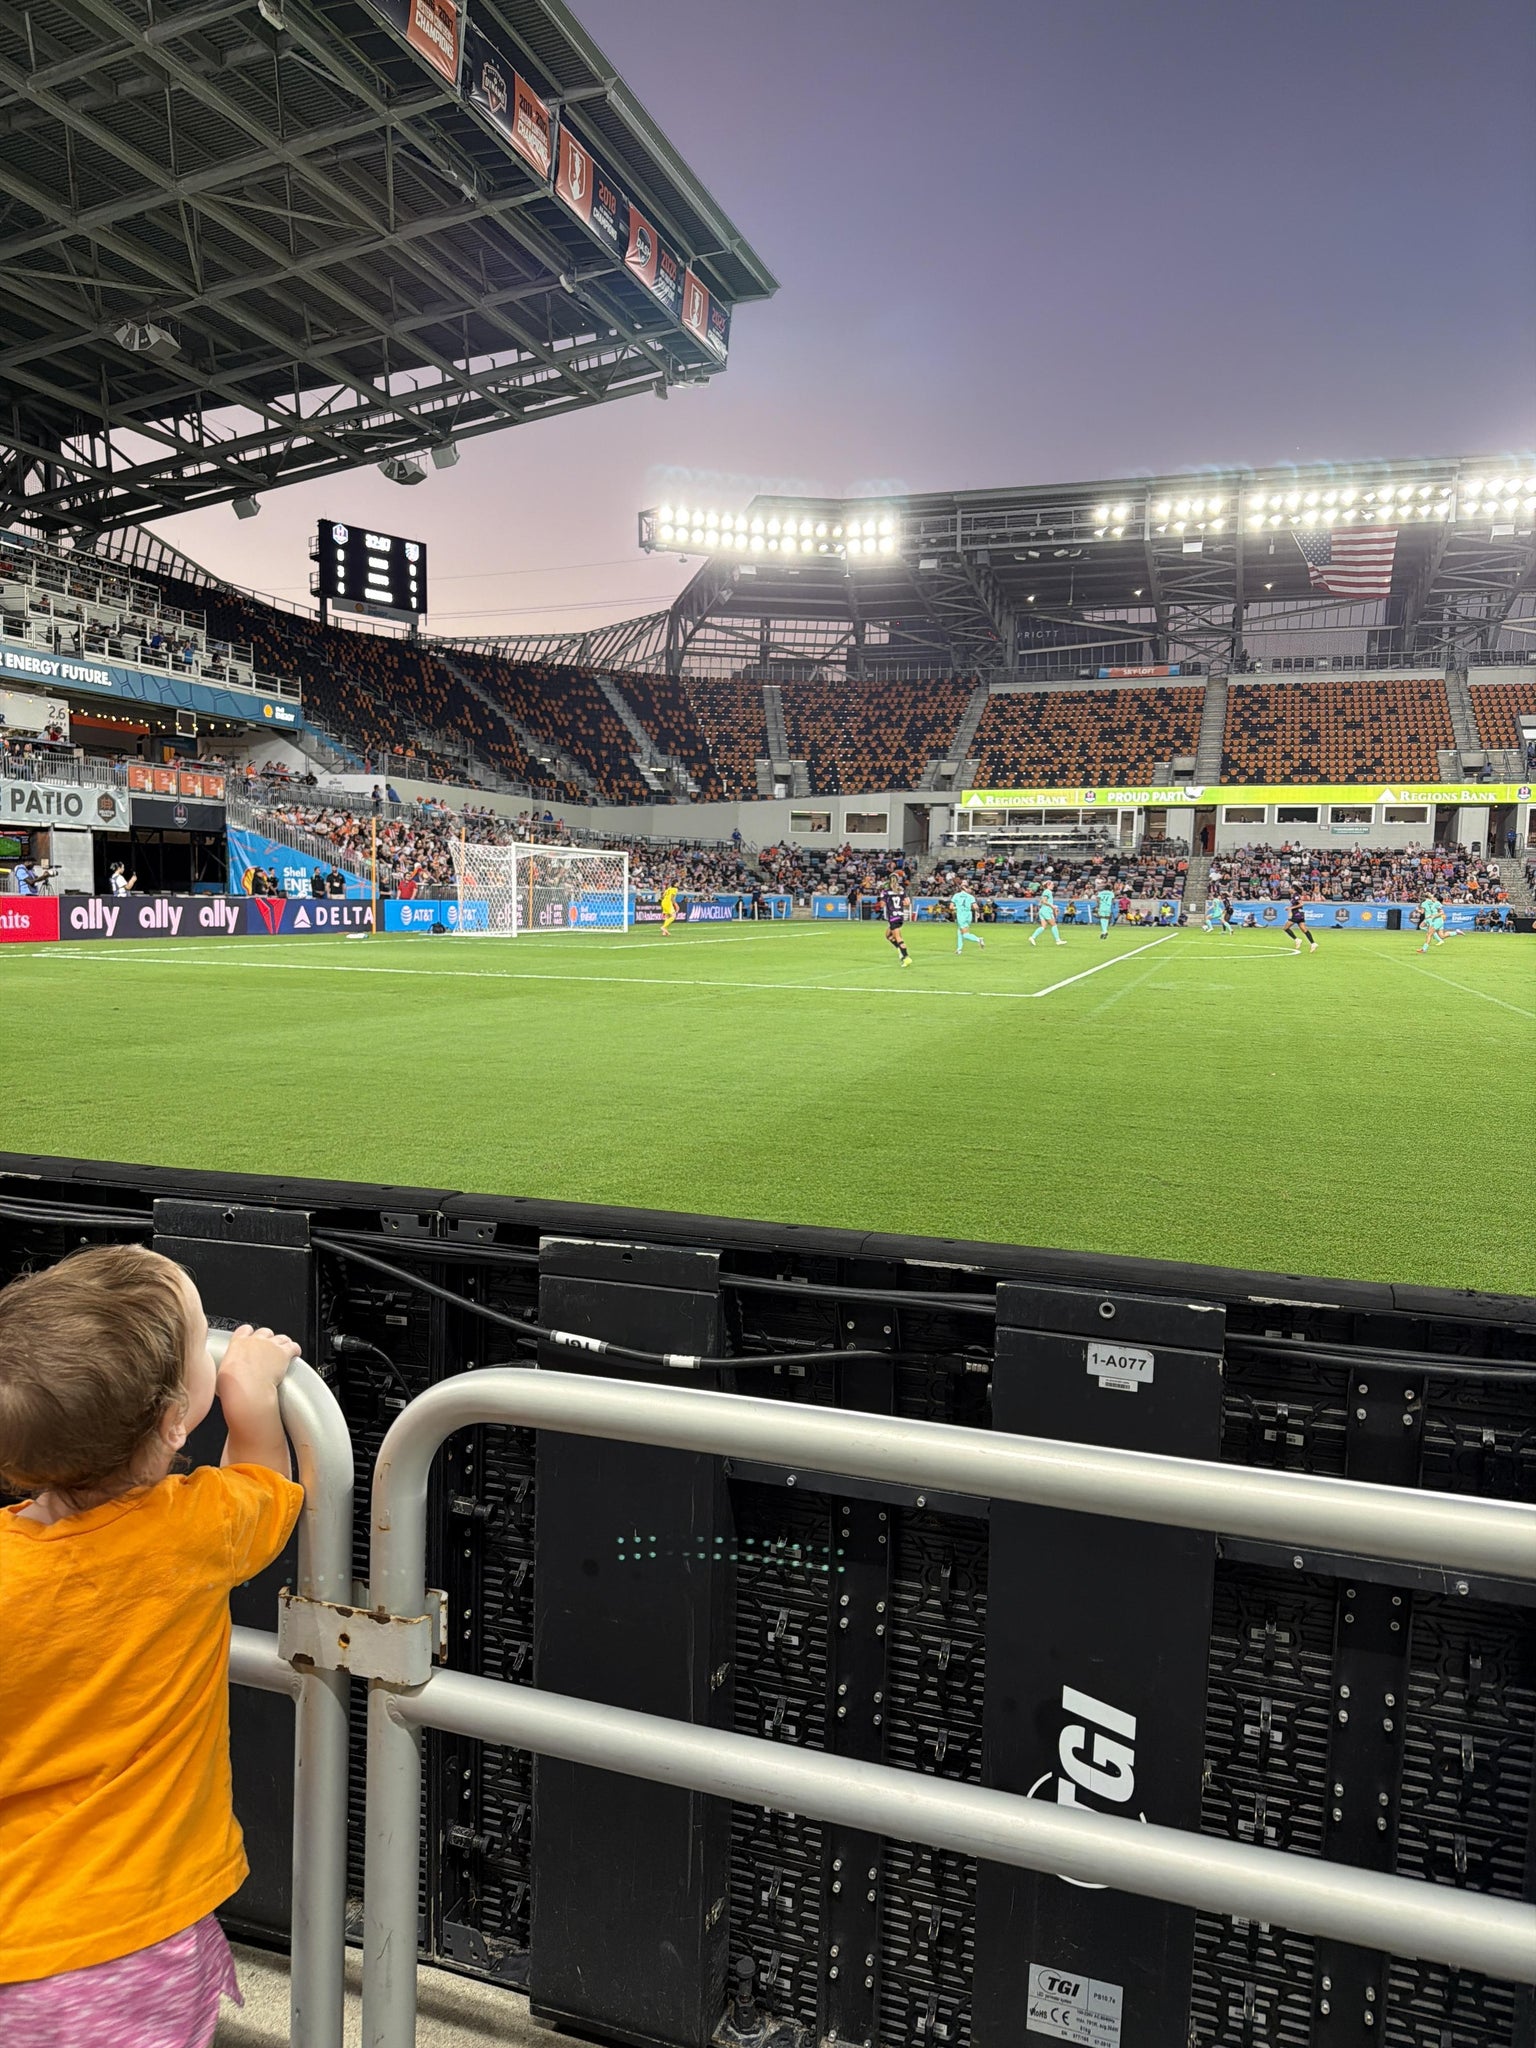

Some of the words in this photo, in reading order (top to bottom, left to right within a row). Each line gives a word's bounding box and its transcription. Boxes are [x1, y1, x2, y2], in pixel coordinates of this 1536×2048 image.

[415, 9, 454, 61] CHAMPIONS
[598, 180, 617, 215] 2018
[593, 206, 618, 241] CHAMPIONS
[5, 653, 60, 676] ENERGY
[61, 664, 113, 687] FUTURE.
[10, 787, 83, 818] PATIO
[985, 795, 1035, 805] REGIONS
[1037, 794, 1068, 806] BANK
[1107, 792, 1149, 802] PROUD
[1400, 790, 1458, 801] REGIONS
[1460, 790, 1497, 801] BANK
[283, 866, 307, 878] Shell
[700, 905, 733, 919] MAGELLAN
[892, 896, 901, 908] 12
[70, 898, 120, 937] ally
[139, 898, 183, 935] ally
[199, 898, 240, 934] ally
[316, 906, 373, 926] DELTA
[413, 908, 434, 922] AT&T
[1092, 1353, 1147, 1371] 1-A077
[1048, 1976, 1080, 1997] TGI
